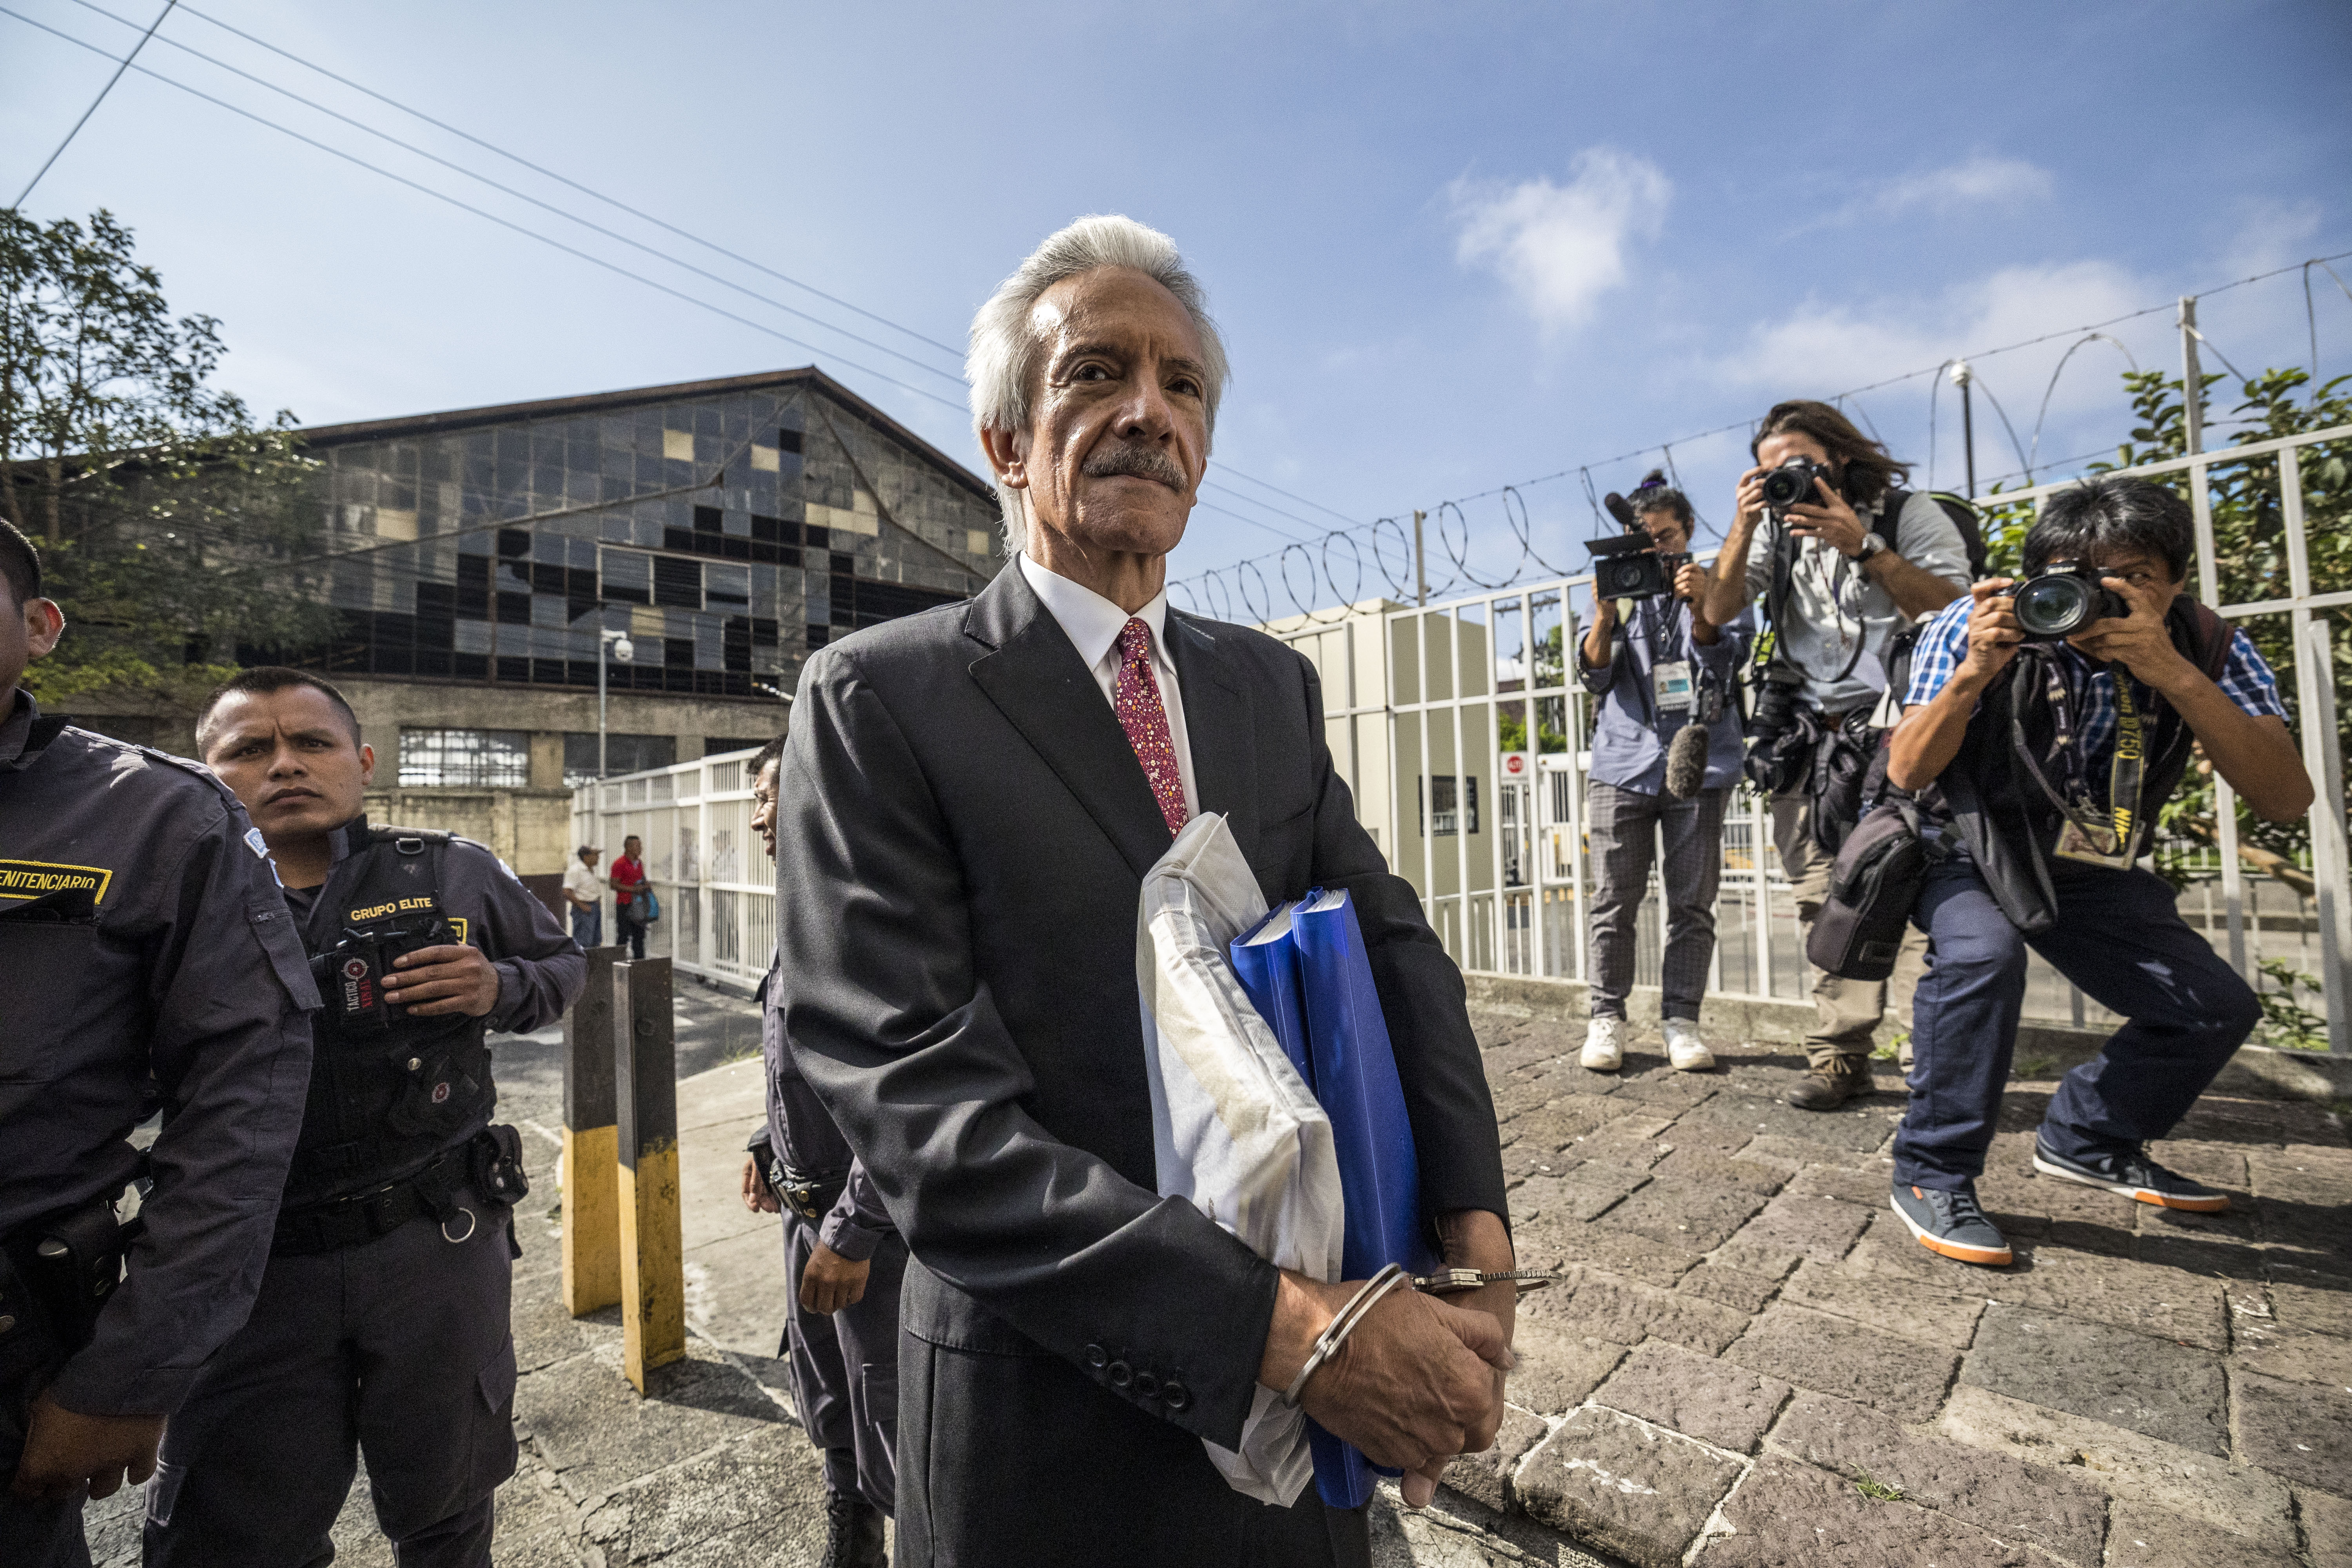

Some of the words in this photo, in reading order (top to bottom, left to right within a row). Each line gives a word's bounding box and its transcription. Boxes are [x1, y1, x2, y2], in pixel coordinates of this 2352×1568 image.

[2117, 717, 2143, 759] D750
[350, 903, 396, 921] GRUPO
[399, 898, 433, 910] ELITE
